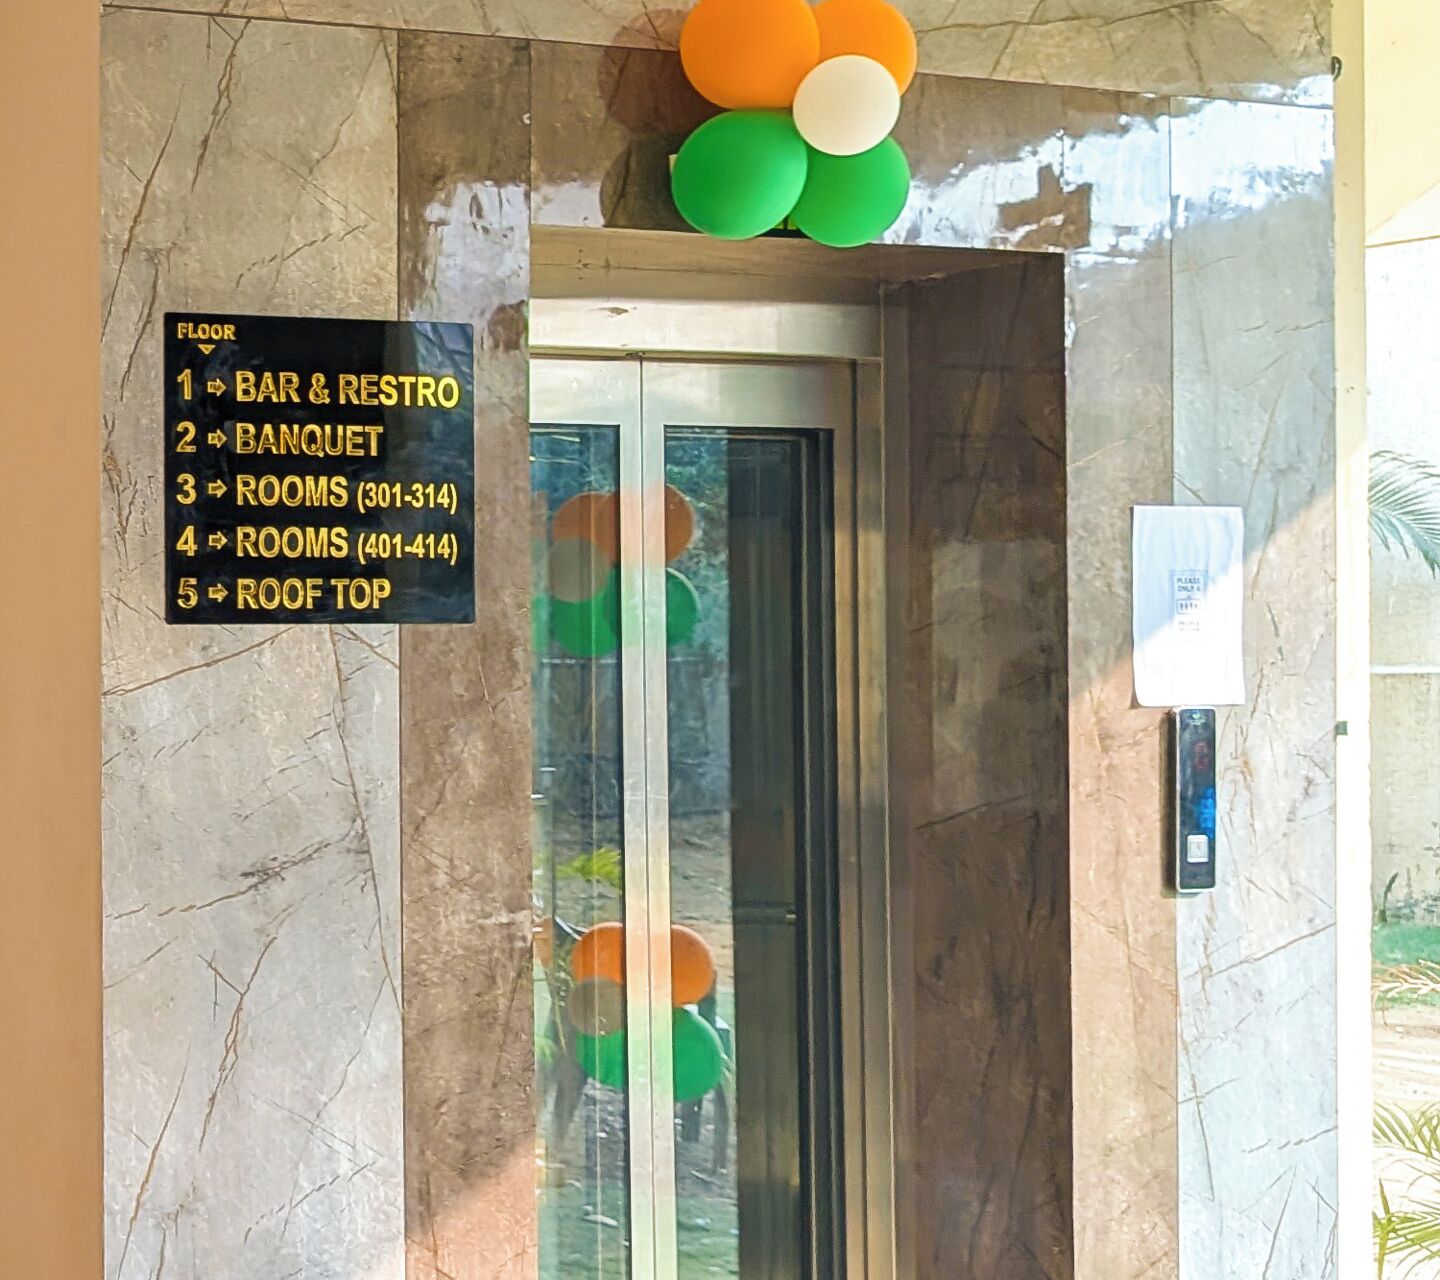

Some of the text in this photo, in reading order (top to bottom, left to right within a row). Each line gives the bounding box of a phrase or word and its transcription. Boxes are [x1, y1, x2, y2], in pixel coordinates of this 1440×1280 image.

[177, 322, 236, 340] FLOOR
[176, 368, 459, 407] 1 BAR & RESTRO
[175, 421, 383, 457] 2 BANQUET
[175, 473, 458, 514] 3 ROOMS (301-314)
[175, 525, 458, 565] 4 ROOMS (401-414)
[176, 577, 391, 609] 5 ROOF TOP
